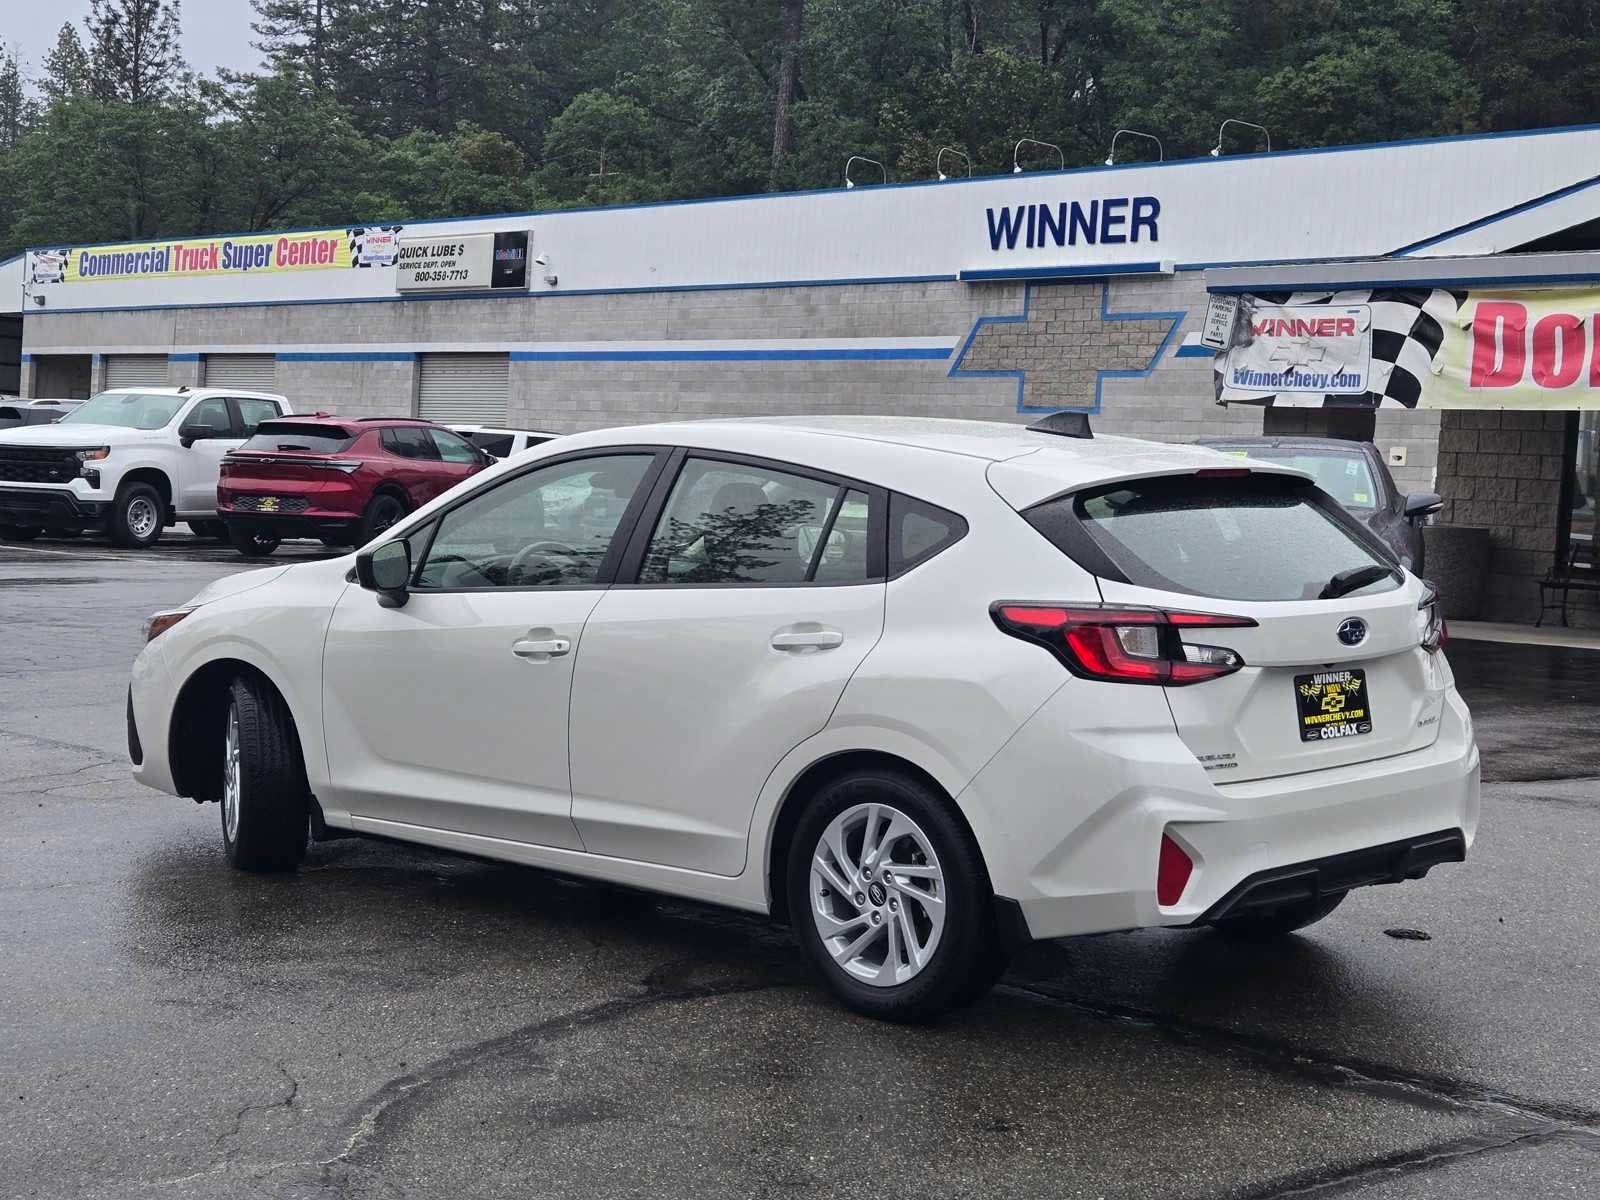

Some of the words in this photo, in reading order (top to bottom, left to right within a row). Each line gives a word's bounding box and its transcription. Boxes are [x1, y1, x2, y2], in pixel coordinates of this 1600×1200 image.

[985, 196, 1161, 251] WINNER
[79, 246, 170, 277] Commercial
[174, 243, 218, 272] Truck
[222, 241, 273, 271] Super
[276, 238, 337, 267] Center
[399, 246, 429, 259] QUICK
[431, 245, 456, 257] LUBE
[399, 261, 422, 270] SERVICE
[440, 260, 456, 268] OPEN
[1250, 317, 1355, 337] WINNER
[1233, 368, 1361, 389] WinnerChevy.com
[1313, 671, 1351, 685] WINNER
[1304, 709, 1364, 725] WINNERCHEVY.COM
[1320, 723, 1358, 739] COLFAX
